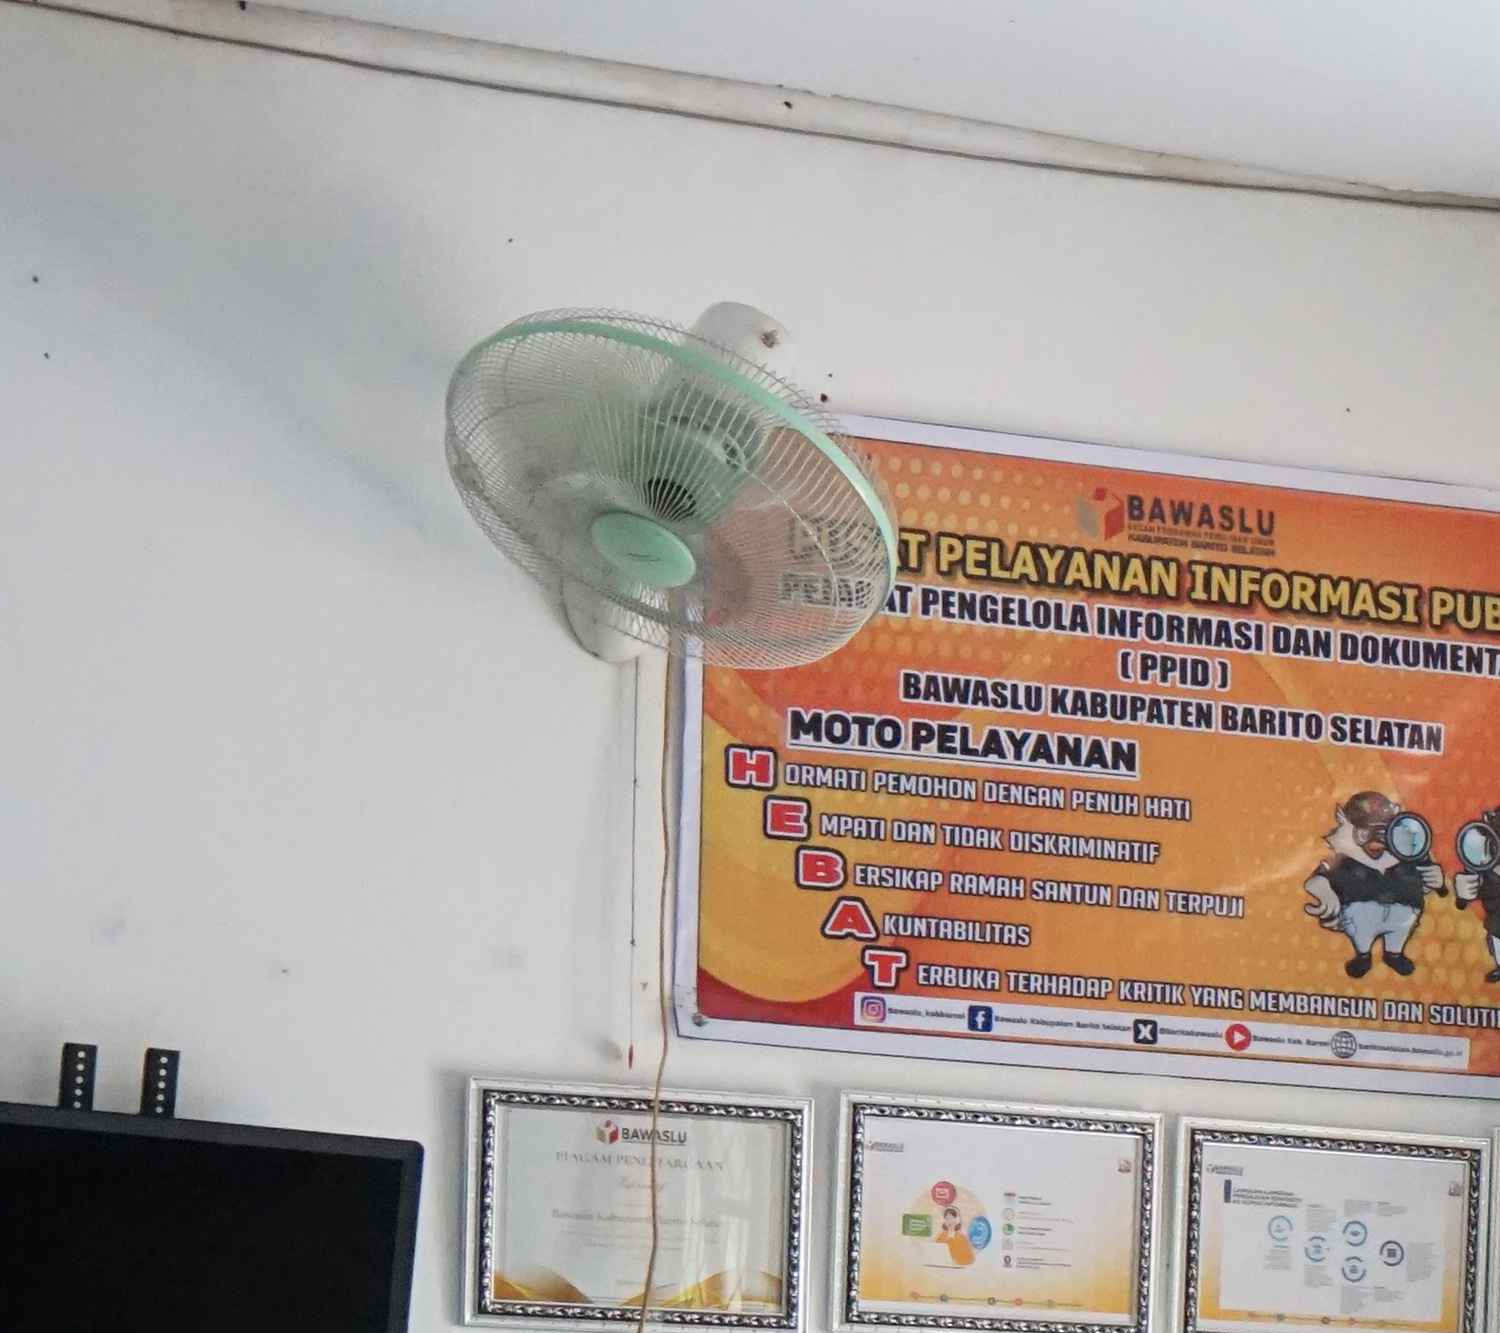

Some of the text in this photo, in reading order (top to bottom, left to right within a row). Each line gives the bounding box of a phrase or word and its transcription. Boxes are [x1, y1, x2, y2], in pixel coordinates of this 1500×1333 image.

[1127, 495, 1275, 536] BAWASLU
[938, 535, 1179, 598] PELAYANAN
[1190, 564, 1420, 624] INFORMASI
[921, 587, 1089, 634] PENGELOLA
[1098, 606, 1263, 651] INFORMASI
[1272, 624, 1332, 661] DAN
[1139, 655, 1210, 687] PPID
[902, 672, 1443, 753] BAWASLU KABUPATEN BARITO SELATAN
[789, 709, 1137, 774] MOTO PELAYANAN
[783, 763, 866, 791] ORMATI
[873, 770, 976, 801] PEMOHON
[983, 780, 1064, 809] DENGAN
[1071, 789, 1138, 817] PENUH
[1145, 797, 1192, 821] HATI
[819, 813, 885, 840] MPATI
[892, 819, 935, 845] DAN
[941, 823, 1003, 851] TIDAK
[1009, 830, 1162, 865] DISKRIMINATIF
[854, 864, 943, 891] ERSIKAP
[949, 871, 1025, 899] RAMAH
[1030, 879, 1112, 906] SANTUN
[1118, 886, 1160, 910] DAN
[1166, 892, 1245, 918] TERPUJI
[883, 914, 1031, 947] KUNTABILITAS
[916, 964, 1000, 992] ERBUKA
[1006, 971, 1113, 1000] TERHADAP
[1119, 982, 1184, 1005] KRITIK
[1189, 986, 1243, 1010] YANG
[1249, 992, 1377, 1020] MEMBANGUN
[1383, 1001, 1424, 1024] DAN
[622, 1127, 687, 1144] BAWASLU
